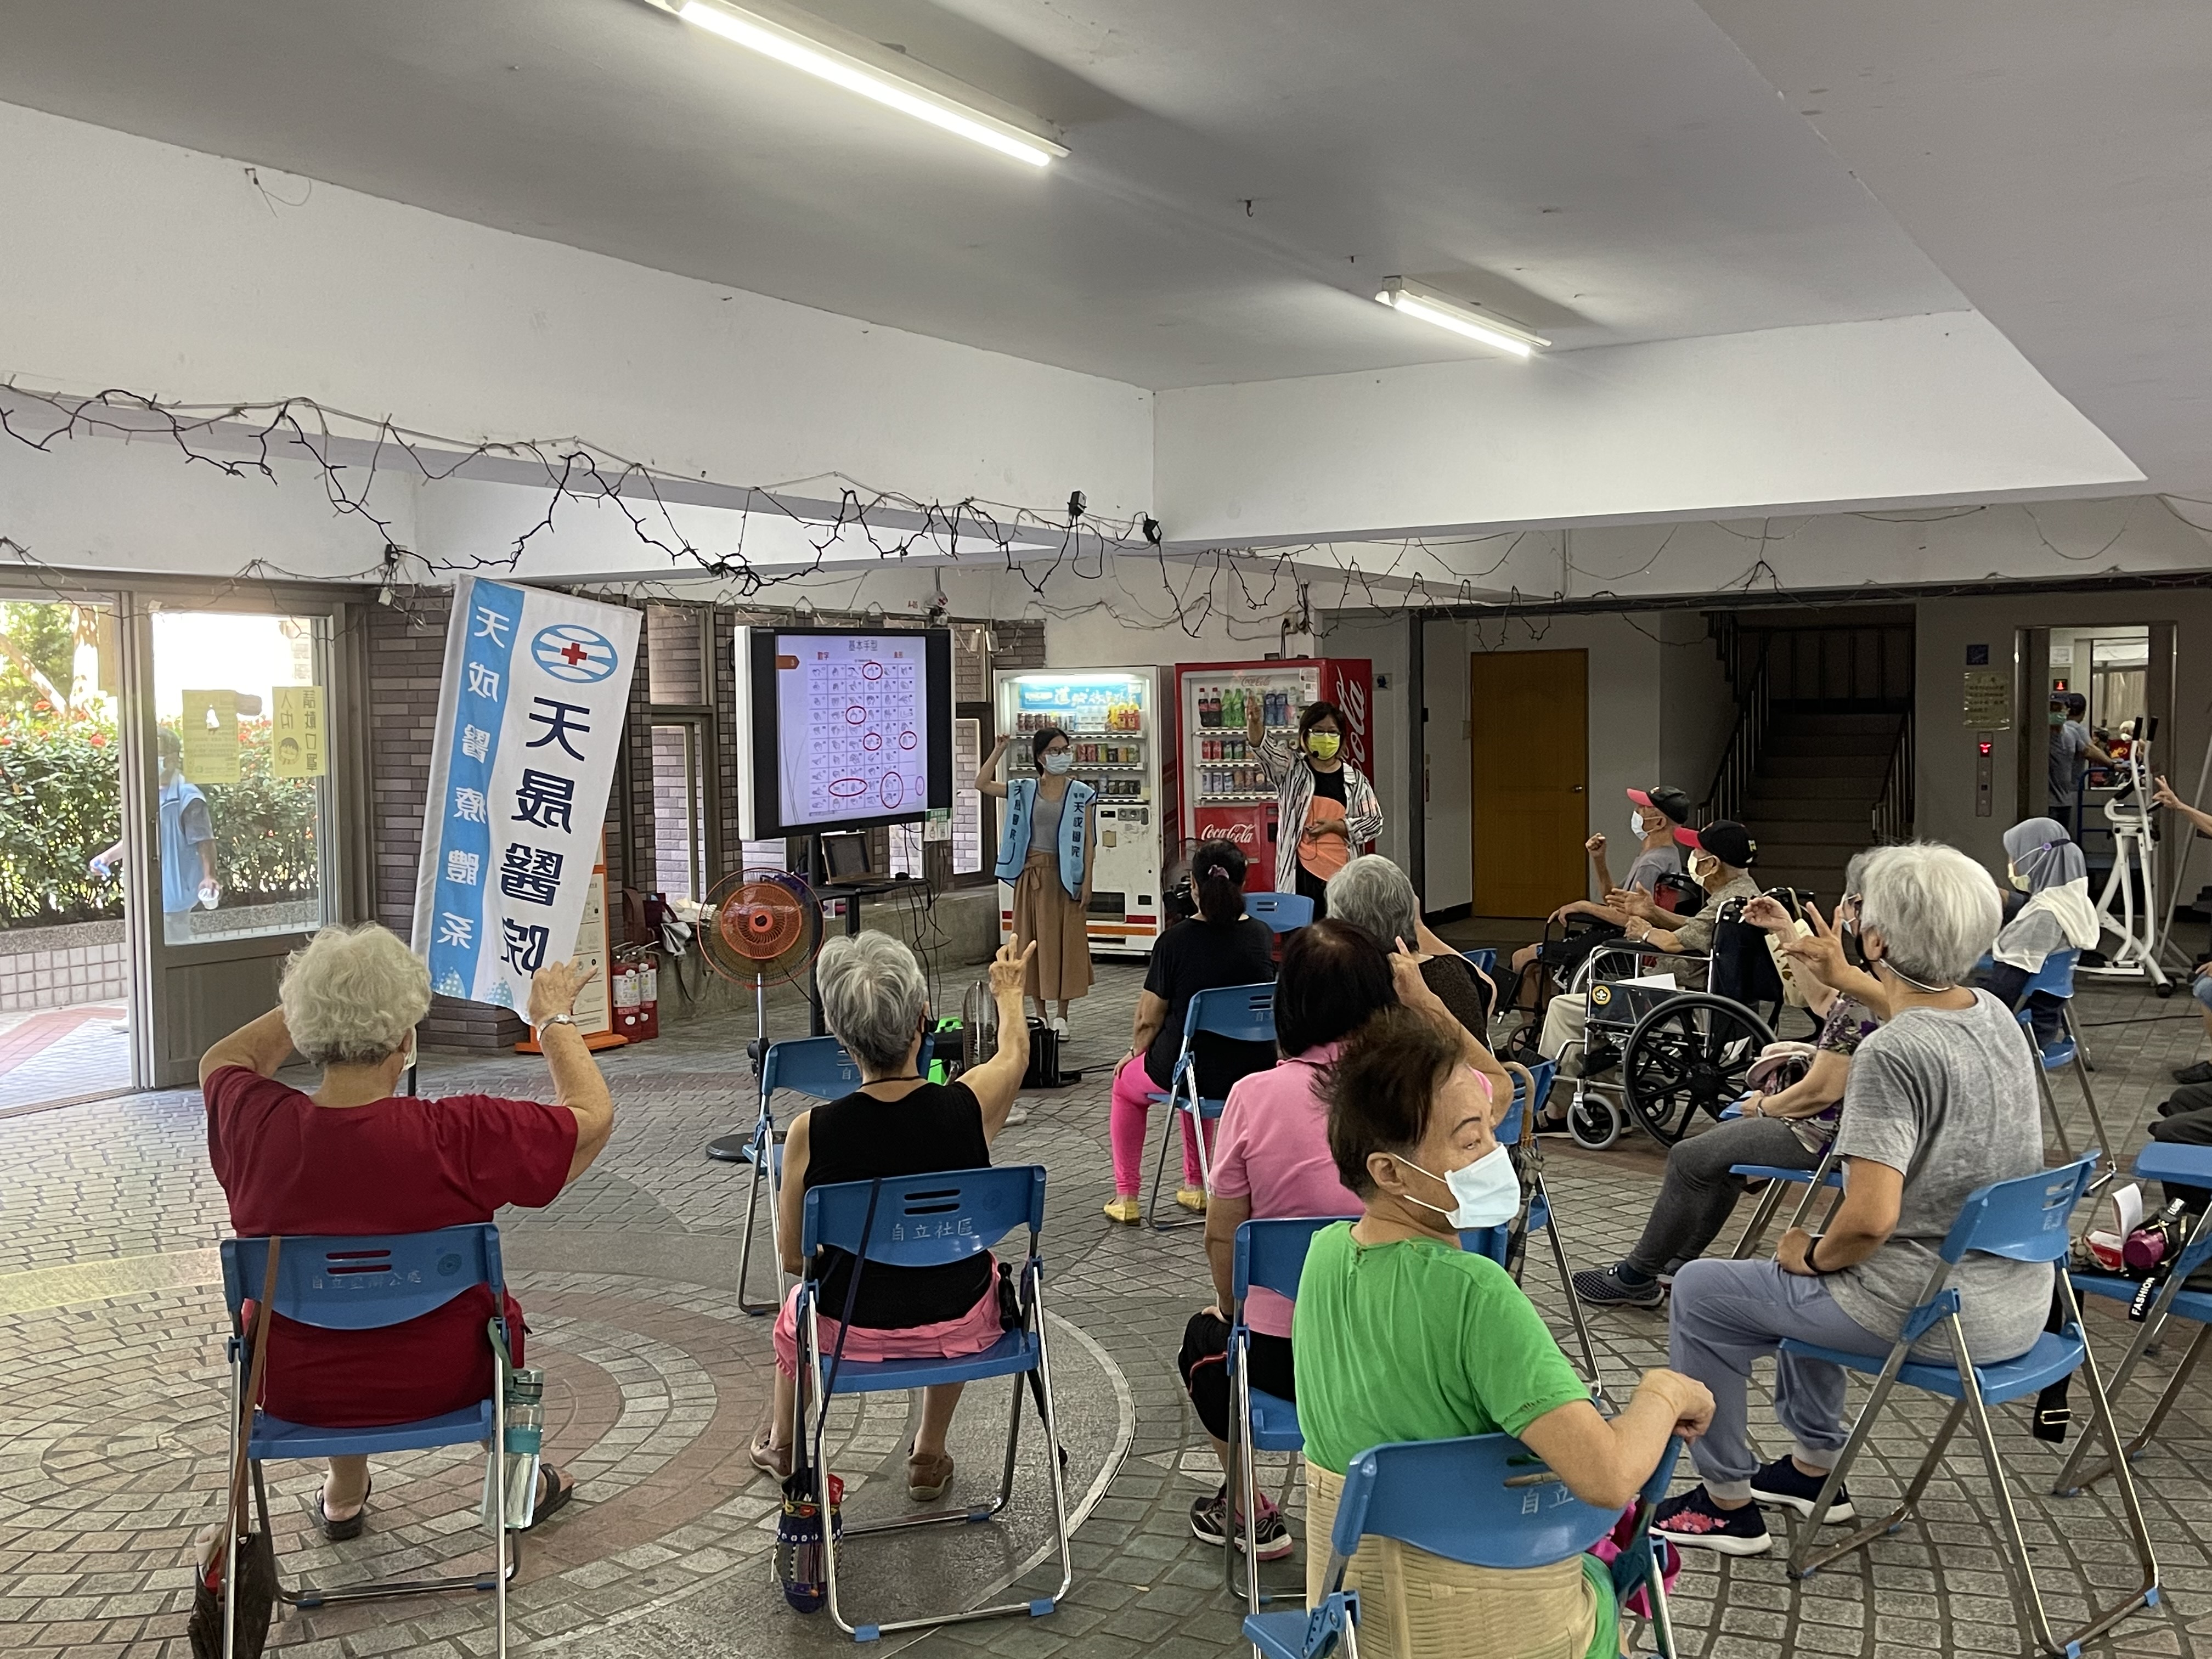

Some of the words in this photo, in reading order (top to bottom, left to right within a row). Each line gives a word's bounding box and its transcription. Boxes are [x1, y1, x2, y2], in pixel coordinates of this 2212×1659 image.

[892, 1217, 973, 1241] 自立社區
[2131, 1277, 2155, 1316] FASHION
